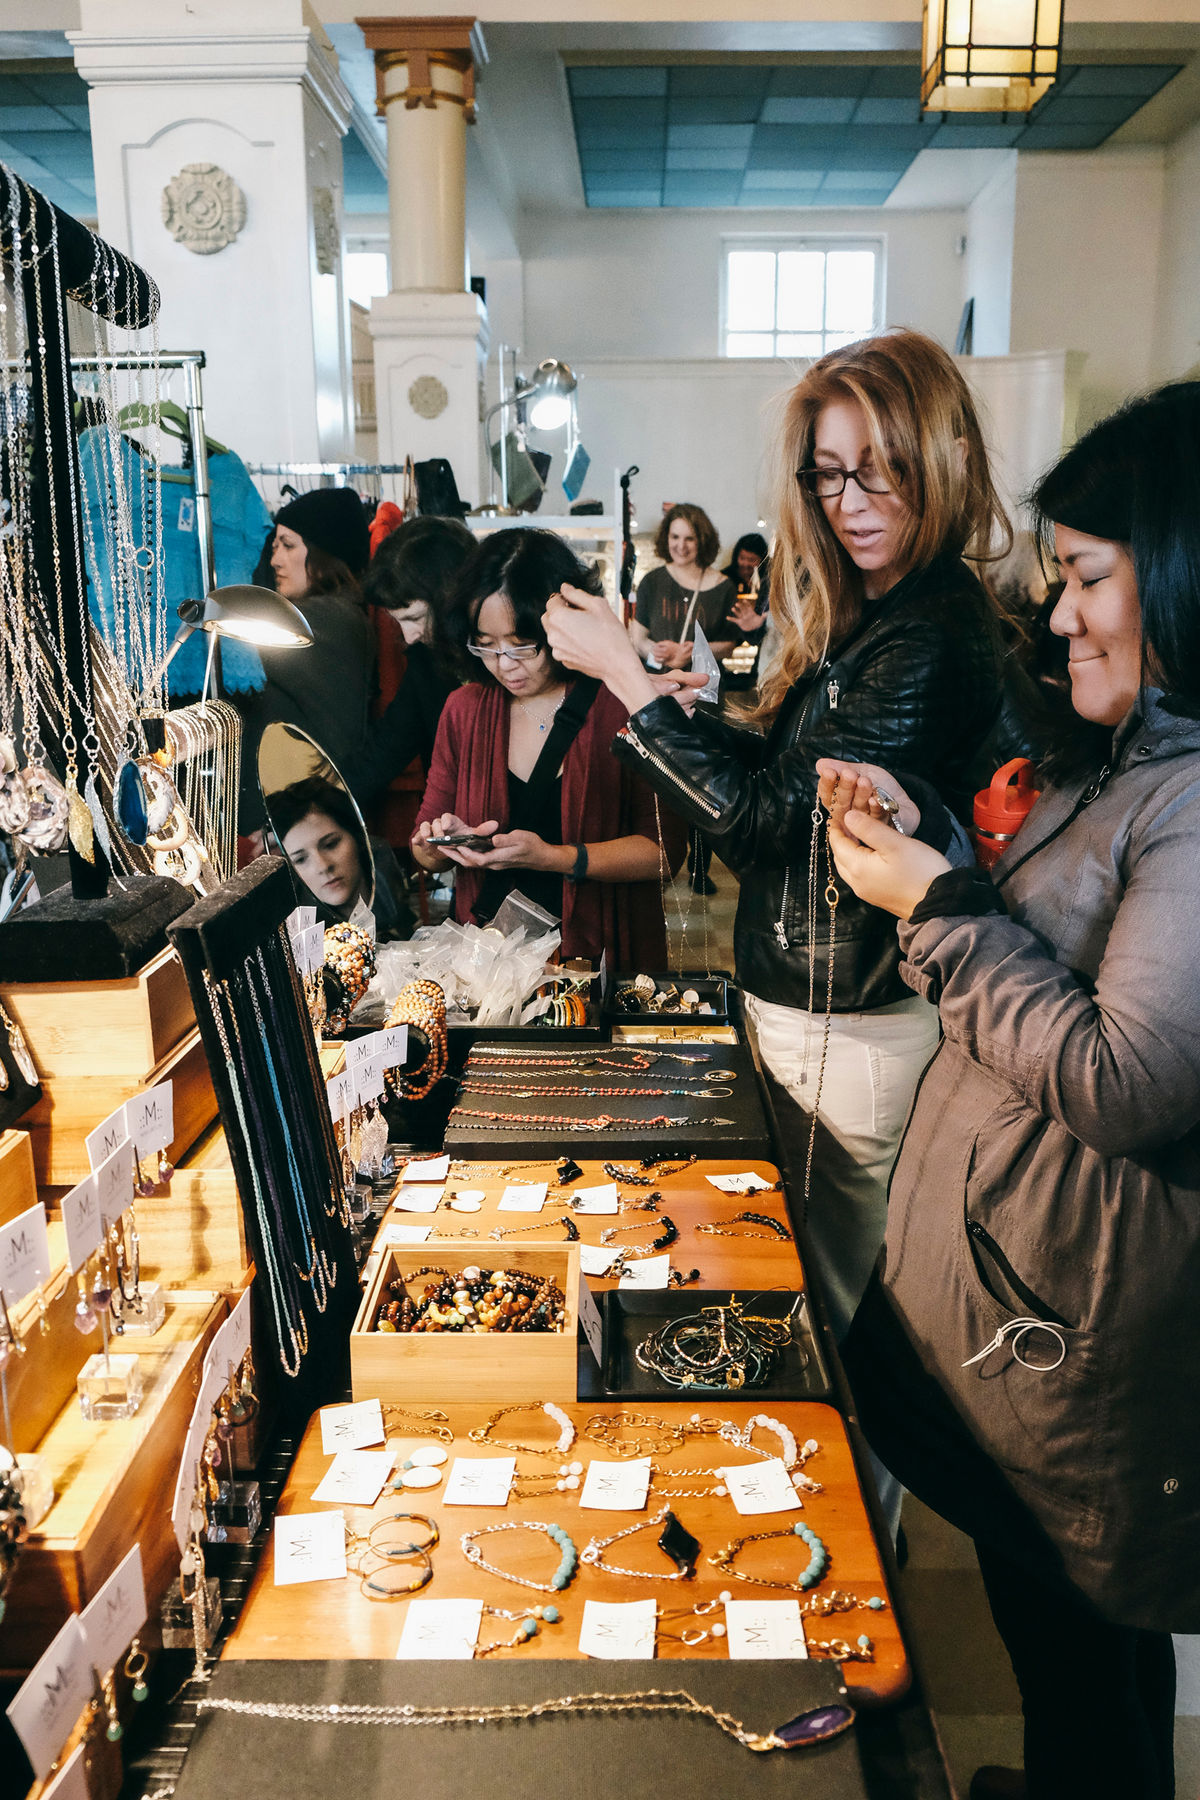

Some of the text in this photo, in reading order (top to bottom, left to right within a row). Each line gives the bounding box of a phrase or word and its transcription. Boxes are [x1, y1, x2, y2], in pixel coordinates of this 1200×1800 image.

[144, 1101, 156, 1126] M
[10, 1231, 27, 1264] M
[289, 1539, 312, 1557] M
[744, 1627, 768, 1643] M
